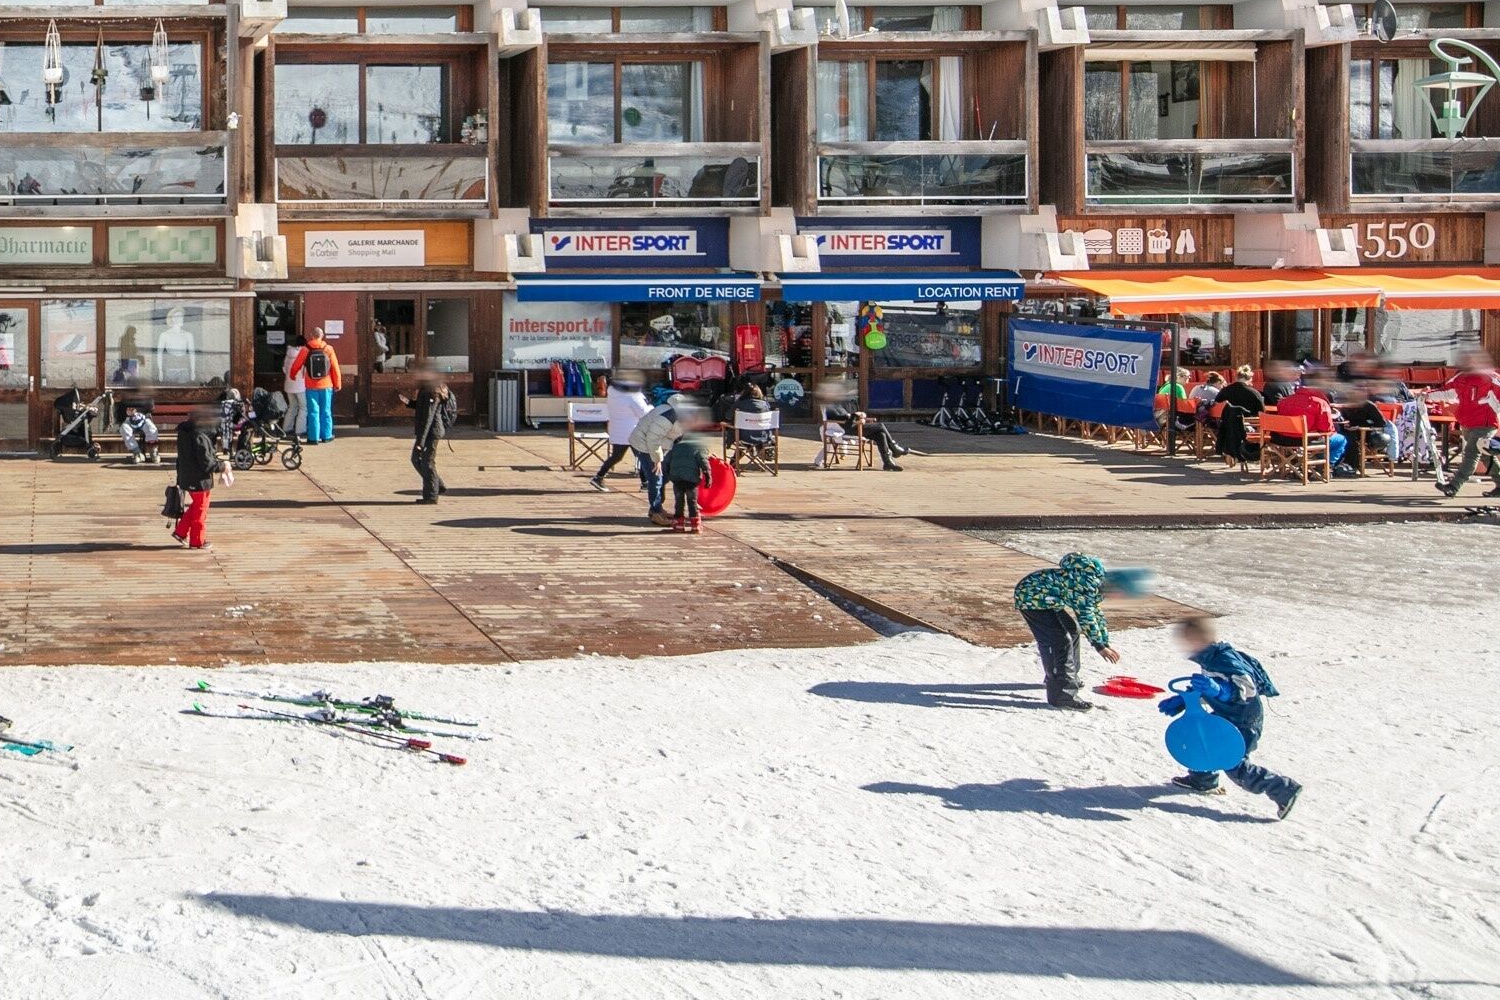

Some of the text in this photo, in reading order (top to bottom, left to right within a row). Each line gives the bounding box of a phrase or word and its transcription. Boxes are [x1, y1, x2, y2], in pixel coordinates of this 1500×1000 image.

[575, 235, 690, 251] INTERSPORT
[831, 234, 945, 250] INTERSPORT
[1346, 221, 1436, 259] 1550
[315, 249, 339, 257] Corbier
[347, 249, 381, 257] Shopping
[648, 287, 754, 298] FRONT DE NEIGE
[918, 287, 1019, 298] LOCATION RENT
[509, 318, 606, 335] intersport.fr
[1038, 344, 1140, 374] INTERSPORT
